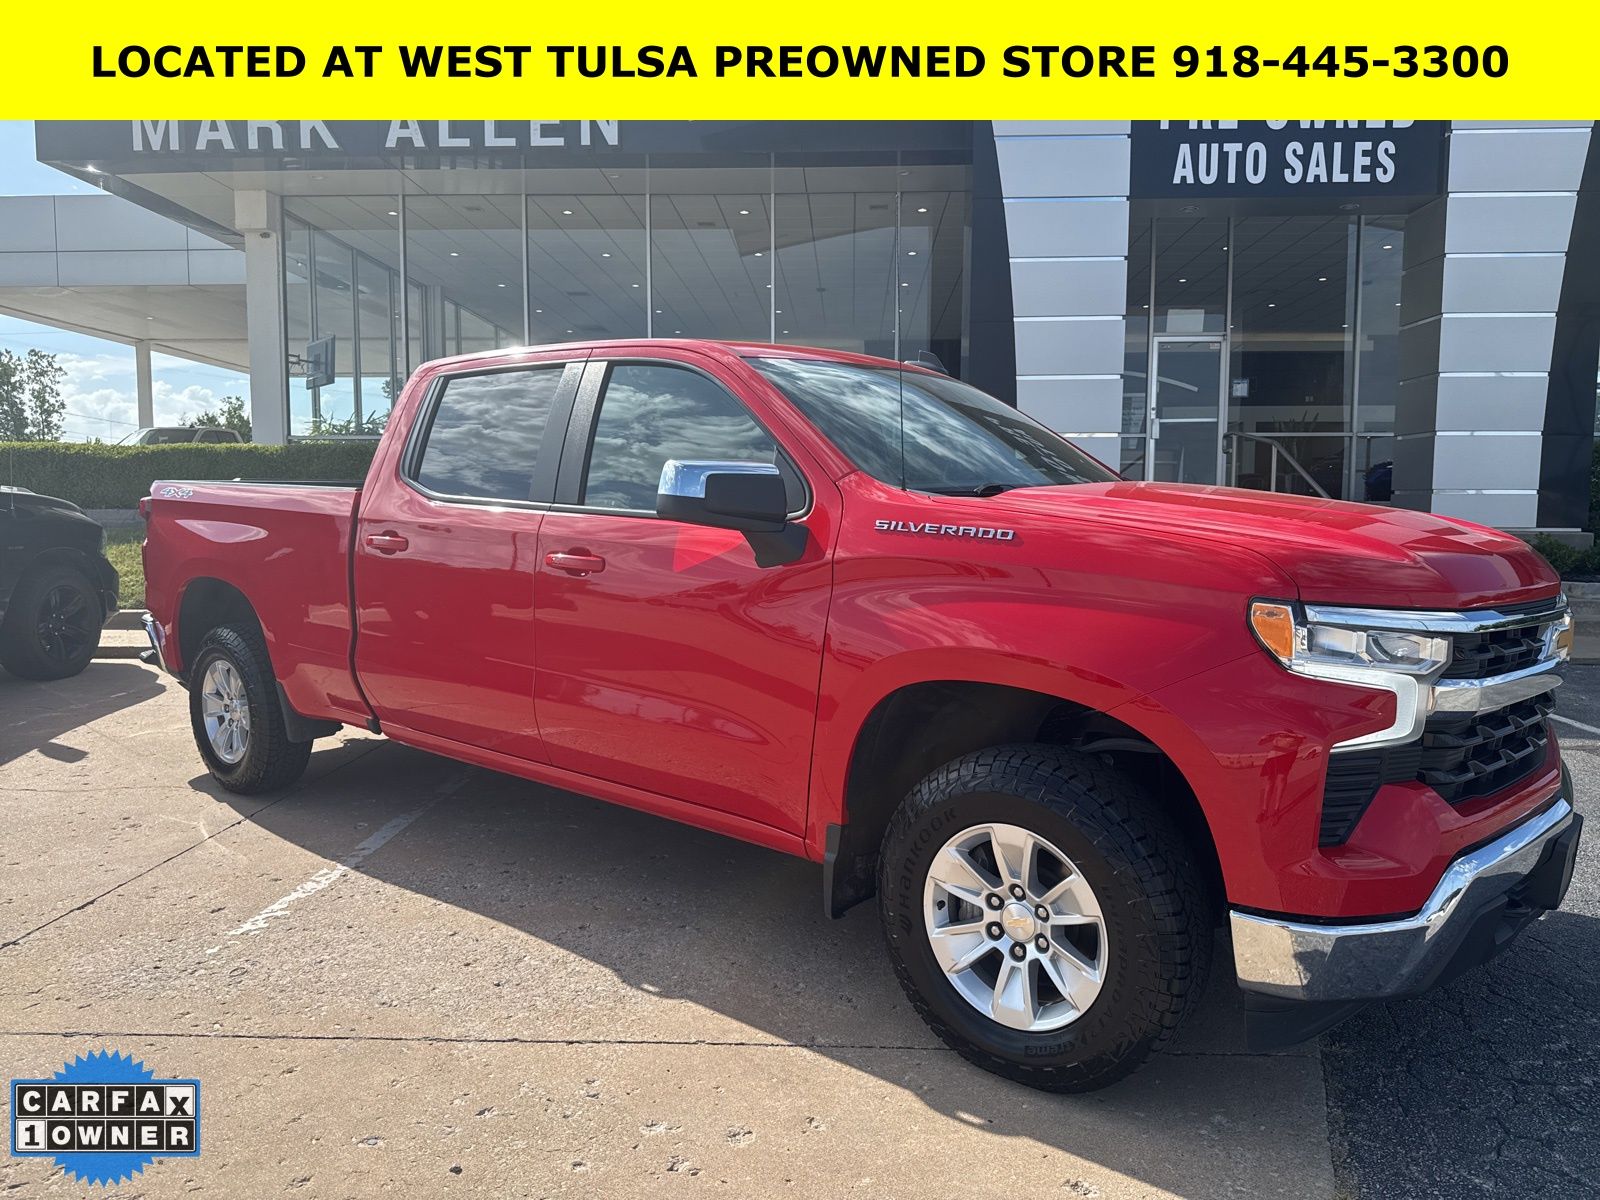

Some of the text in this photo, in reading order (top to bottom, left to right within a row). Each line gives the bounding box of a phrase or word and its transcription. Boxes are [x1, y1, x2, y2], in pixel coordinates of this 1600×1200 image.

[131, 120, 619, 151] MARK ALLEN
[1172, 140, 1396, 185] AUTO SALES
[874, 519, 1016, 541] SILVERADO
